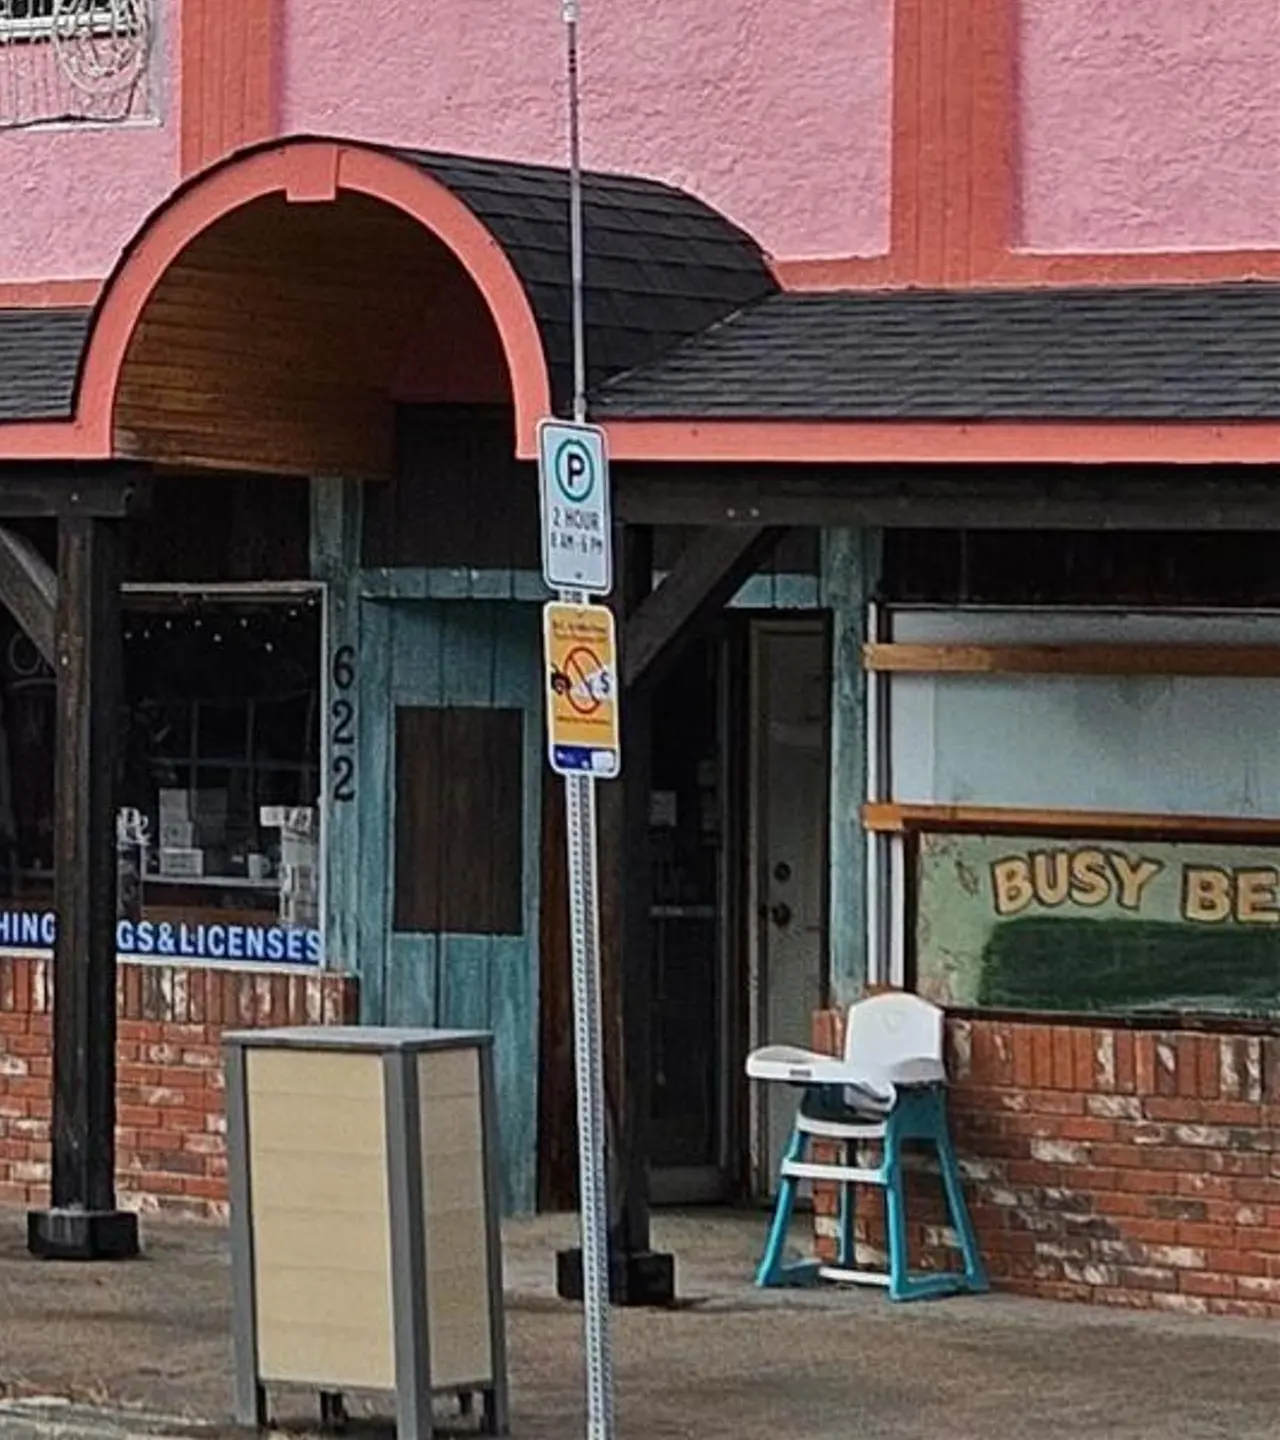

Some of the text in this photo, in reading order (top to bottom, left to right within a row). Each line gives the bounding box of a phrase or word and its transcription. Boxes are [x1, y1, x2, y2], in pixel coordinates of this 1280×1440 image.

[566, 454, 585, 489] P
[565, 508, 600, 531] HOUR
[332, 645, 356, 803] 622
[991, 846, 1164, 916] BUSY
